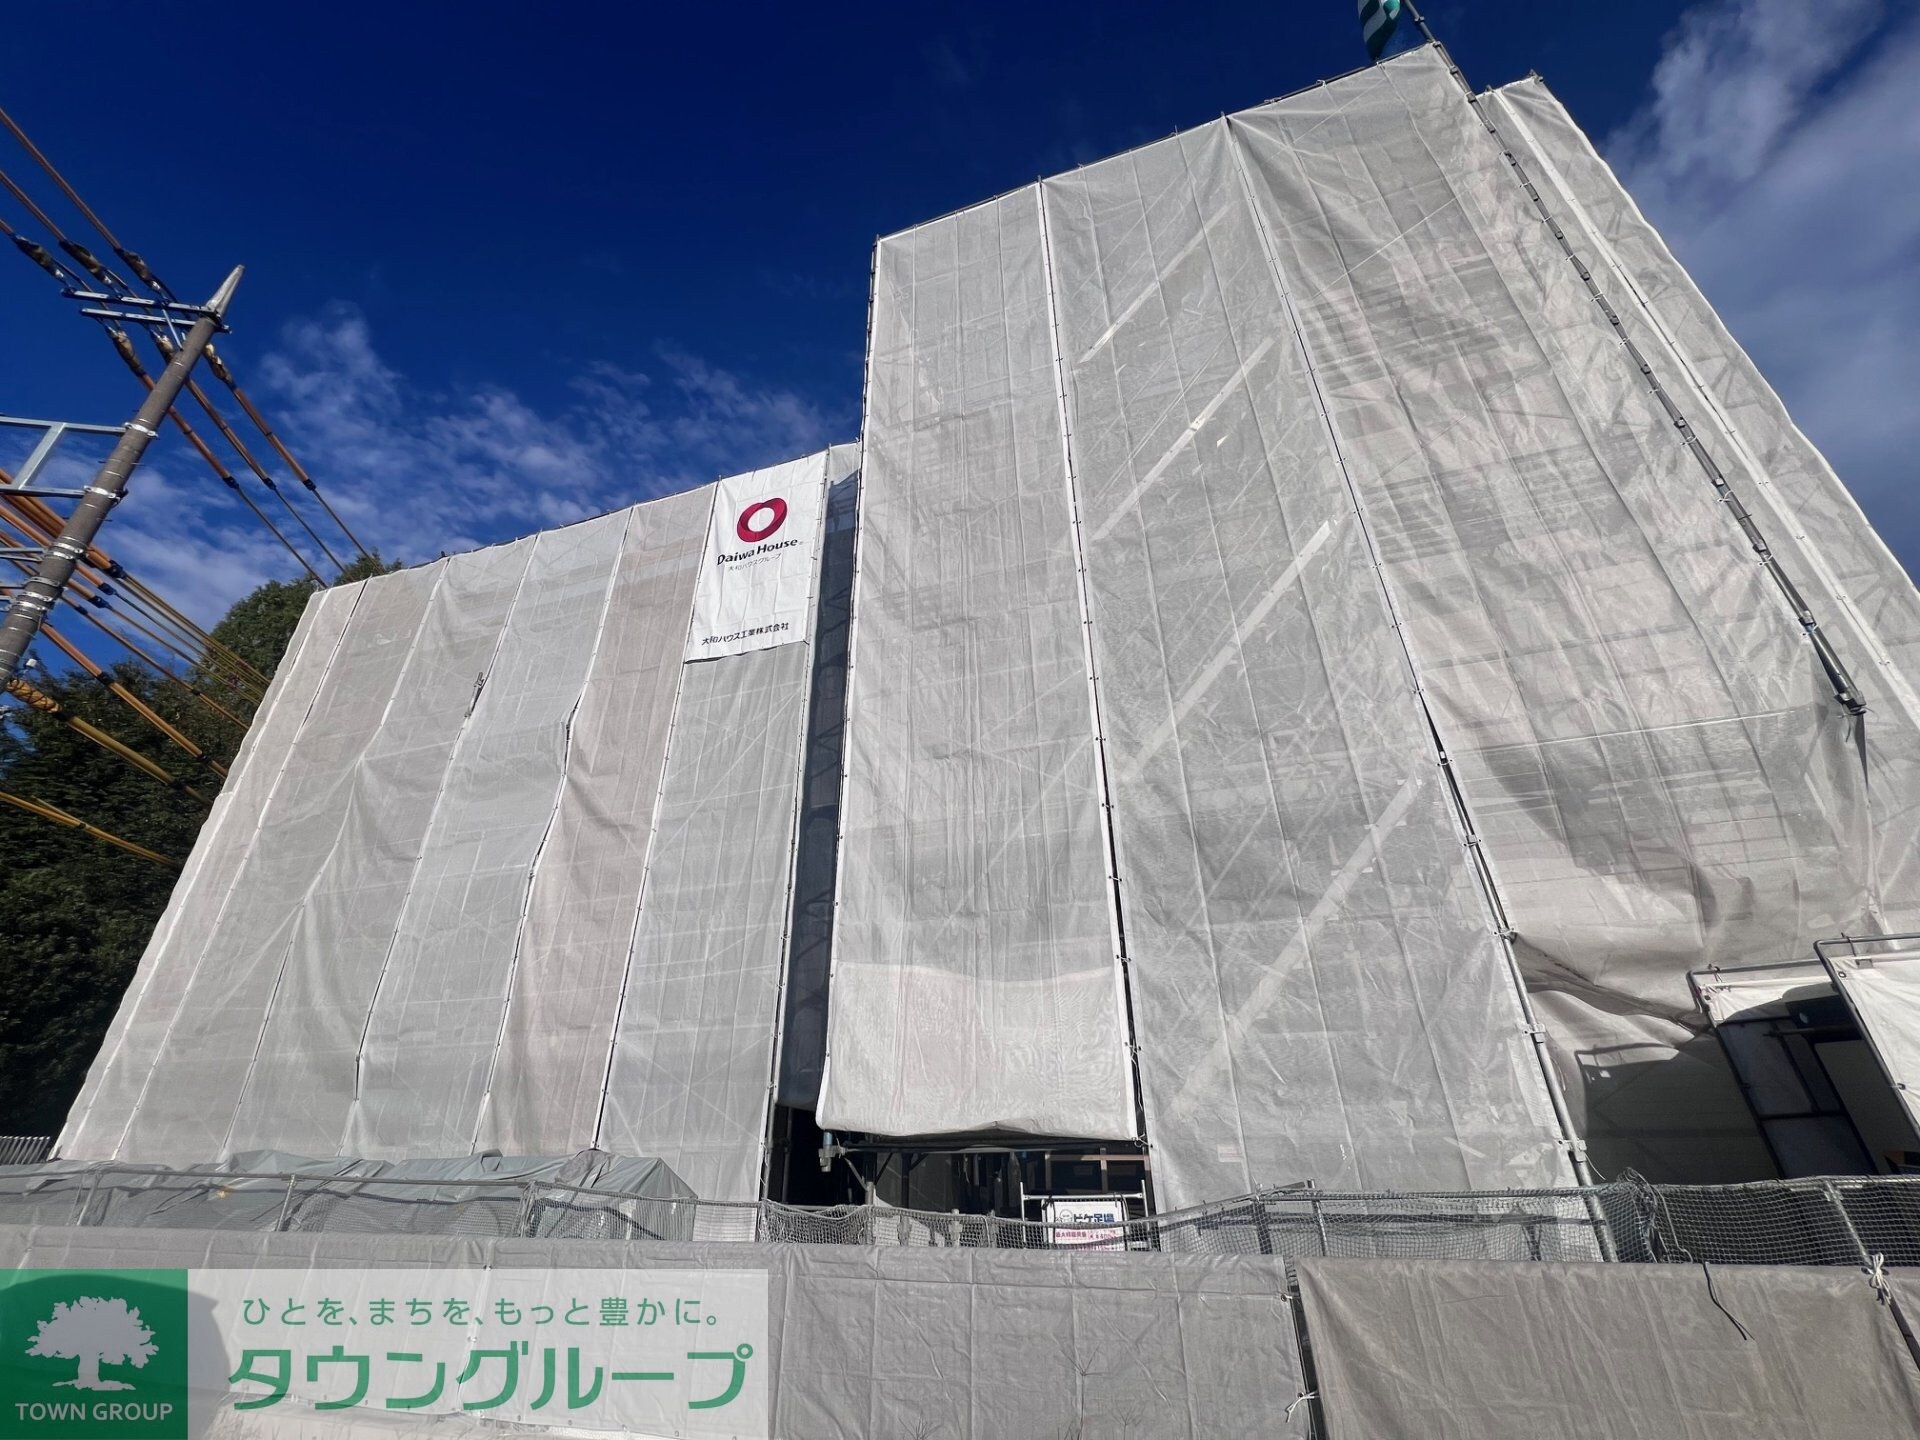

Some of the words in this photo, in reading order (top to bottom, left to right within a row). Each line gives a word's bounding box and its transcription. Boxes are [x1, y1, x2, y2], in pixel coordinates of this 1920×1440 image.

[717, 550, 755, 565] Daiwa
[757, 539, 798, 554] House
[729, 553, 781, 571] 大和ハウスグループ
[702, 622, 789, 645] 大和ハウス工業株式会社
